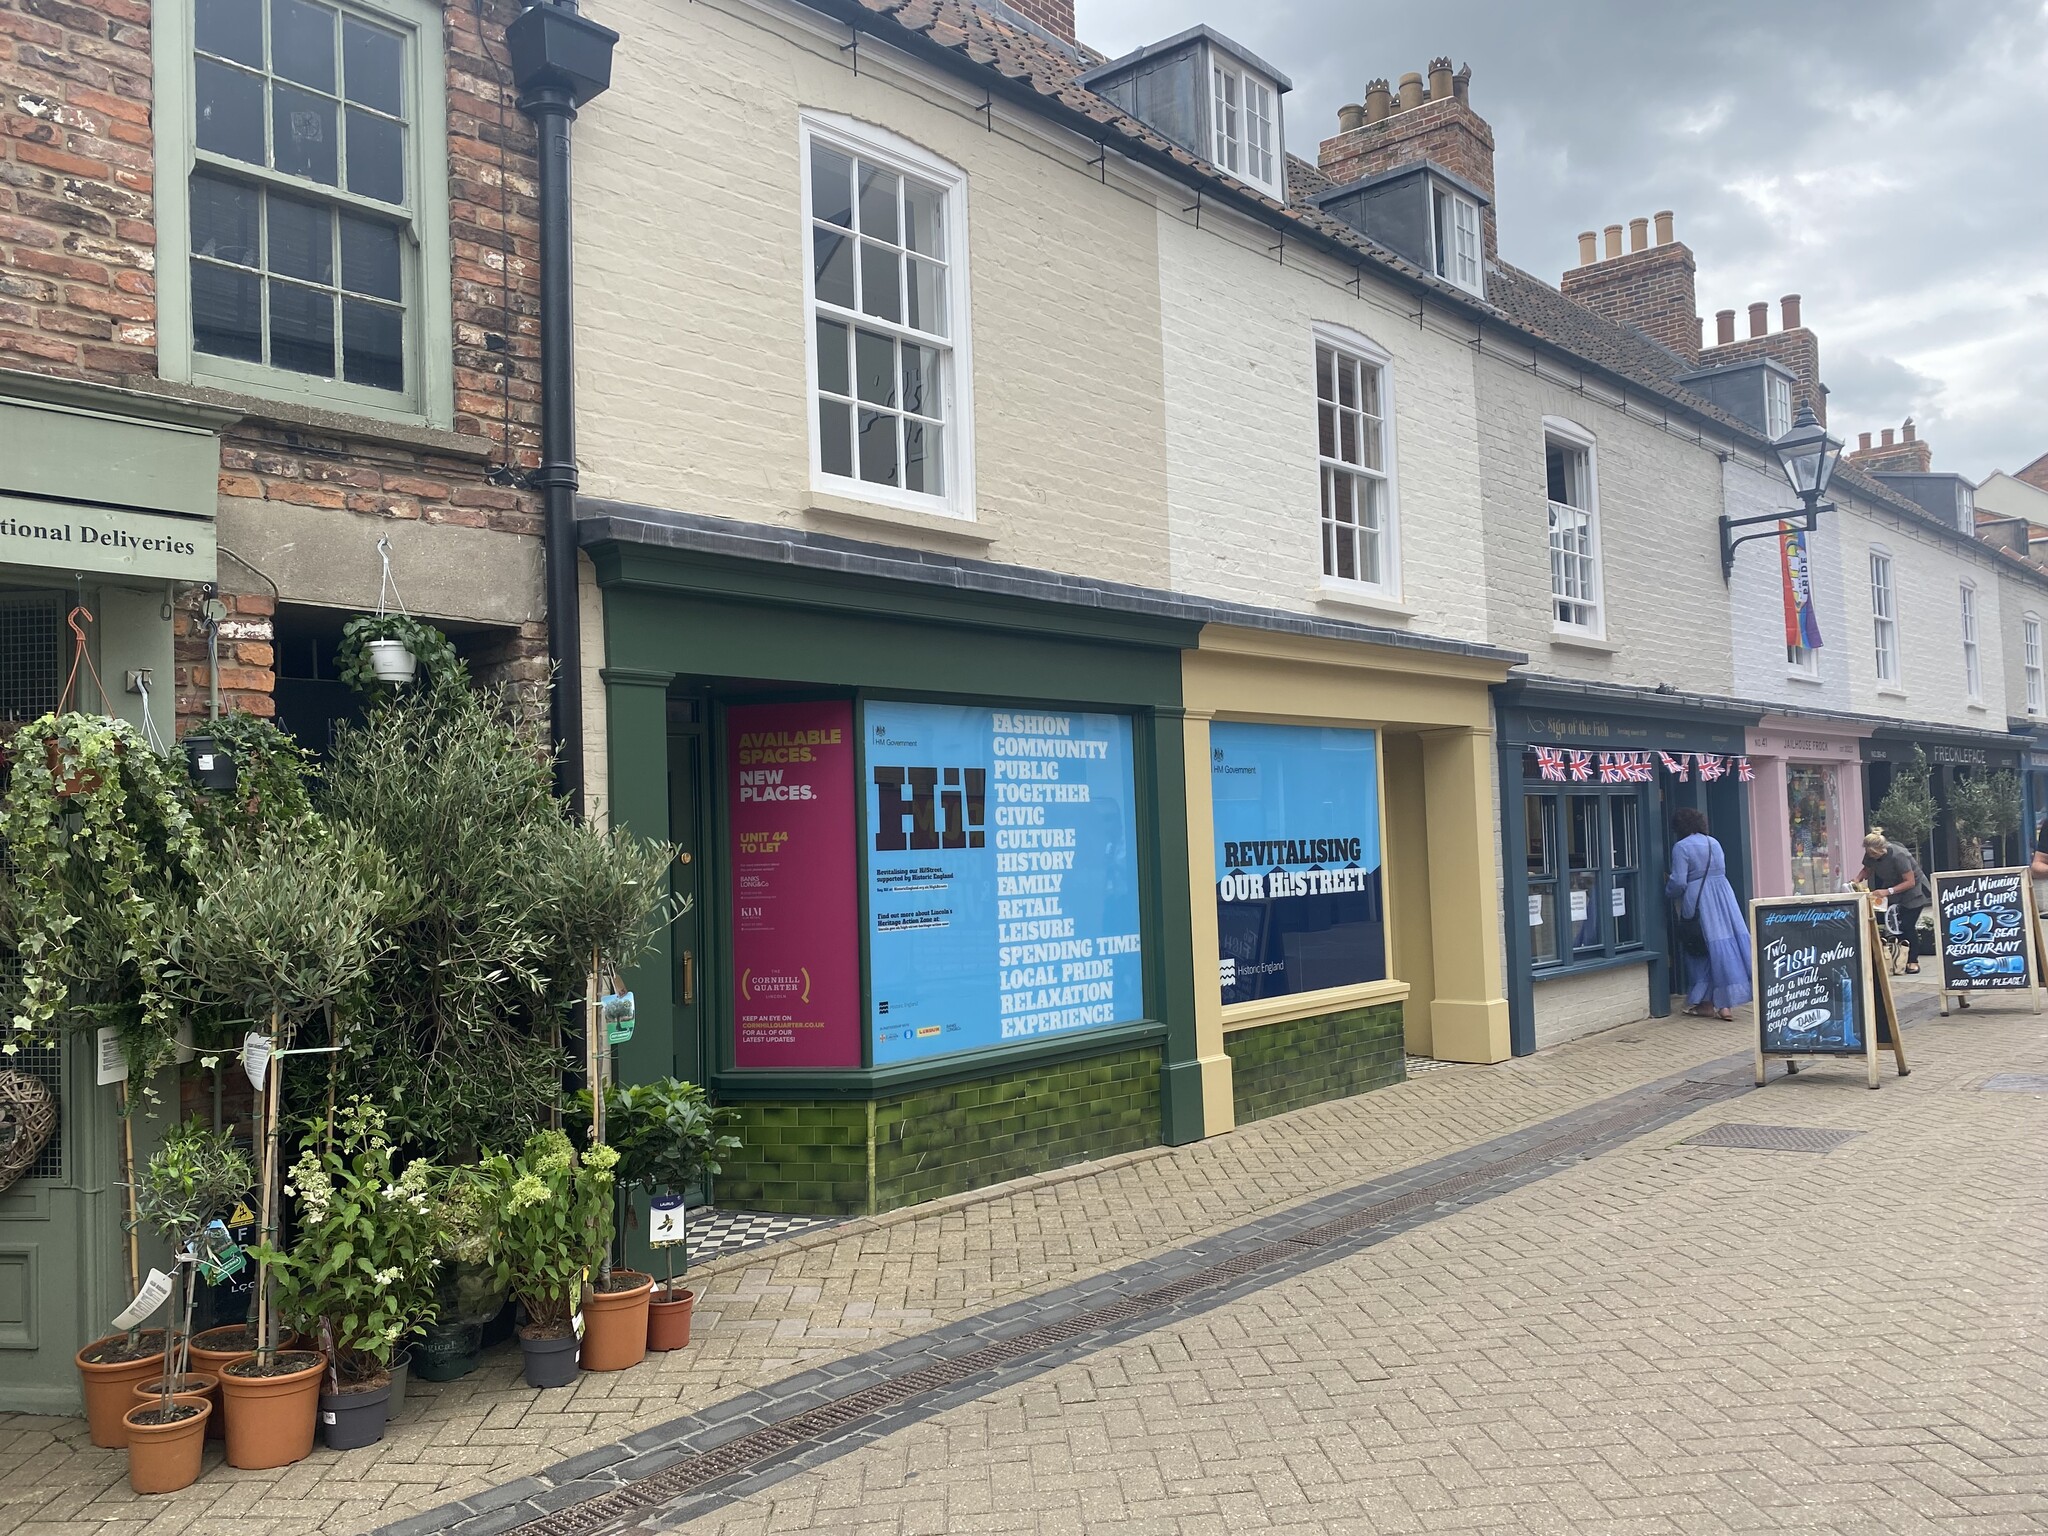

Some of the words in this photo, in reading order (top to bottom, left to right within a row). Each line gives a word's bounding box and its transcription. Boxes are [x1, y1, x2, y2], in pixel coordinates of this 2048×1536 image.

[79, 525, 194, 556] Deliveries
[1800, 557, 1809, 595] PRIDE
[992, 713, 1070, 737] FASHION
[1547, 719, 1566, 740] Sign
[1568, 720, 1578, 735] of
[1579, 720, 1592, 736] the
[1593, 721, 1609, 737] Fish
[739, 728, 842, 748] AVAILABLE
[886, 738, 918, 747] Government
[992, 736, 1108, 760] COMMUNITY
[739, 746, 817, 765] SPACES.
[1934, 745, 1986, 764] FRECKLEFACE
[740, 769, 784, 786] NEW
[994, 759, 1059, 781] PUBLIC
[1213, 765, 1223, 774] HM
[1225, 765, 1256, 775] Government
[740, 784, 817, 802] PLACES.
[994, 783, 1090, 803] TOGETHER
[873, 765, 987, 852] Hi!
[995, 805, 1045, 827] CIVIC
[740, 832, 769, 843] UNIT
[771, 831, 788, 842] 44
[740, 843, 756, 854] TO
[760, 842, 780, 853] LET
[996, 828, 1076, 849] CULTURE
[996, 850, 1075, 873] HISTORY
[1224, 837, 1362, 868] REVITALISING
[876, 868, 908, 876] Revitalising
[877, 875, 903, 883] supported
[933, 873, 954, 881] England
[997, 873, 1064, 896] FAMILY
[1220, 873, 1265, 902] OUR
[1269, 867, 1367, 900] Hi!STREET
[1941, 881, 1977, 905] Award
[1978, 874, 2021, 893] Winning
[998, 896, 1063, 920] RETAIL
[1944, 899, 1972, 919] FISH
[1983, 890, 2018, 908] CHIPS
[1765, 909, 1849, 927] #cornhillquarter
[1949, 912, 1995, 944] 52
[1994, 926, 2020, 940] SEAT
[999, 918, 1074, 944] LEISURE
[999, 937, 1093, 967] SPENDING
[1096, 933, 1141, 955] TIME
[1764, 936, 1788, 961] Two
[1945, 939, 2022, 957] RESTAURANT
[1237, 965, 1260, 976] Historic
[1261, 960, 1284, 975] England
[1773, 945, 1816, 978] FISH
[1819, 942, 1855, 966] swim
[752, 976, 800, 984] CORNHILL
[1000, 963, 1058, 991] LOCAL
[1062, 958, 1114, 981] PRIDE
[1950, 978, 1970, 988] THIS
[1972, 977, 1990, 988] WAY
[1992, 974, 2027, 988] PLEASE!
[1001, 981, 1114, 1015] RELAXATION
[1767, 984, 1785, 997] into
[1788, 979, 1795, 990] a
[1767, 995, 1783, 1009] one
[1784, 989, 1811, 1004] turns
[1813, 984, 1826, 996] to
[1766, 1008, 1782, 1021] the
[1782, 1001, 1808, 1015] other
[1810, 992, 1829, 1006] and
[1001, 1003, 1115, 1039] EXPERIENCE
[1767, 1018, 1789, 1034] says
